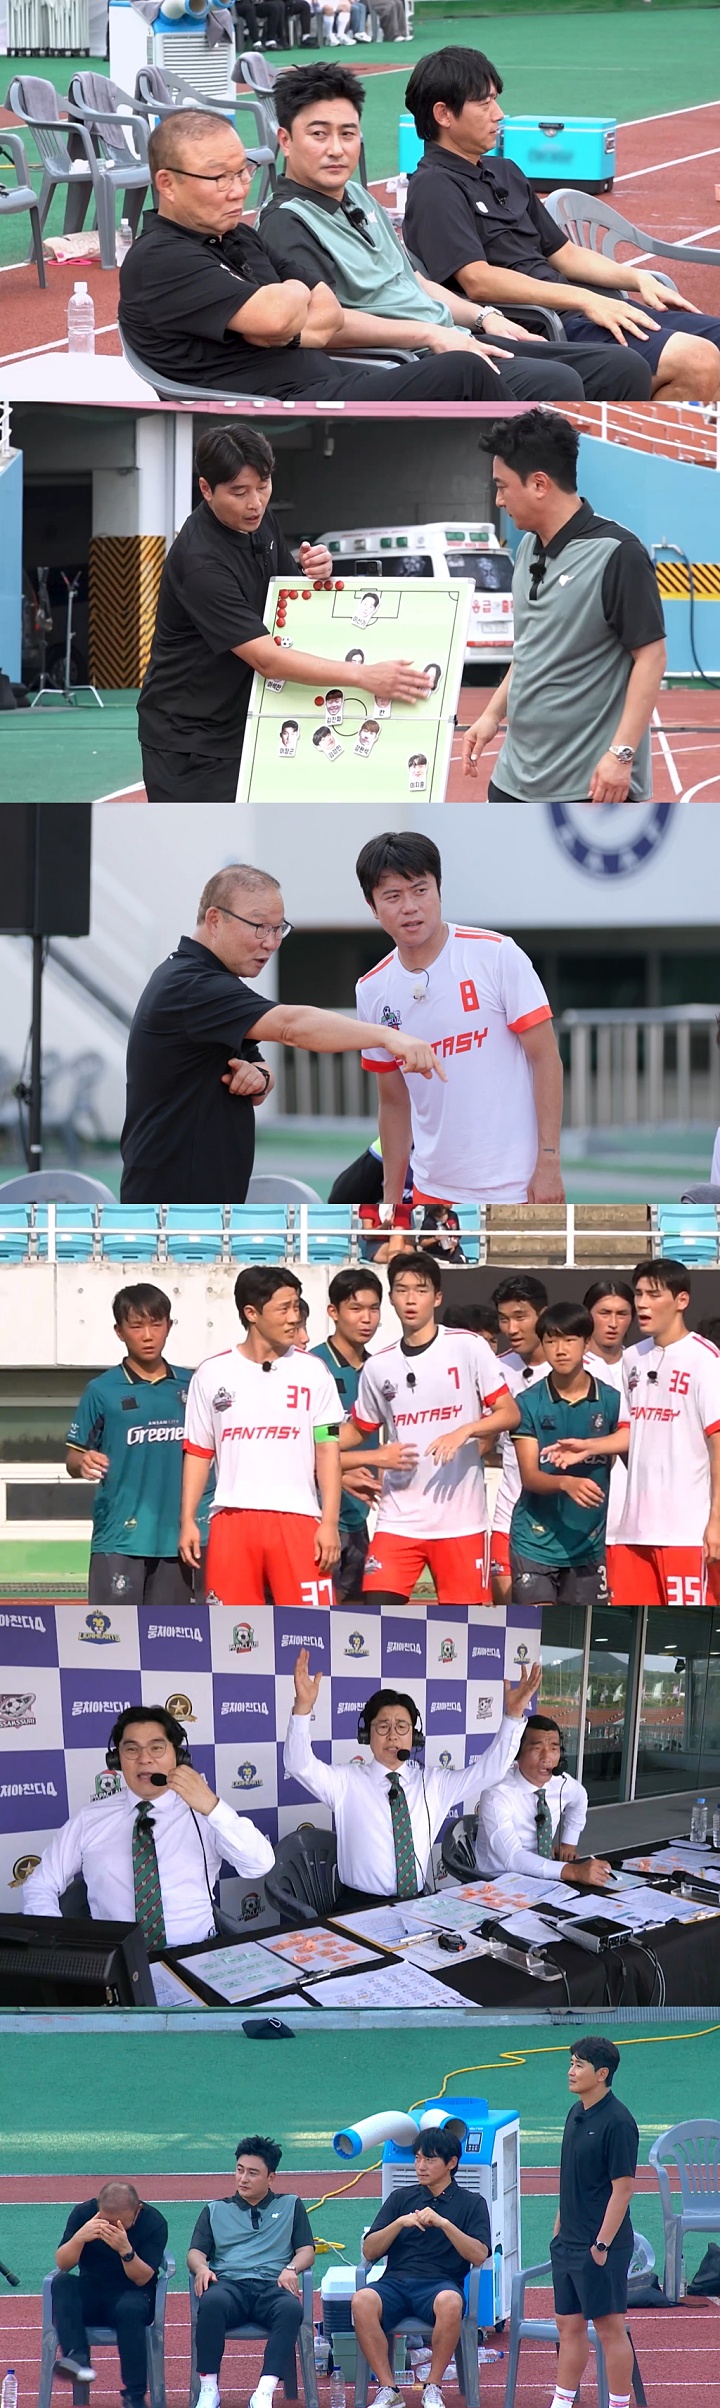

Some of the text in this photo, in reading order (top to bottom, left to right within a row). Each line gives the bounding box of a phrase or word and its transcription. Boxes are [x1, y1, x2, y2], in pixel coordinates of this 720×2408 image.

[460, 979, 480, 1012] 8
[448, 1367, 460, 1389] 7
[669, 1370, 690, 1395] 35
[287, 1385, 310, 1411] 37
[221, 1426, 300, 1442] FANTASY
[301, 1579, 332, 1605] 37
[667, 1576, 700, 1605] 35
[78, 1631, 121, 1643] LIONHEARTS
[148, 1624, 203, 1642] 뭉쳐야찬다4
